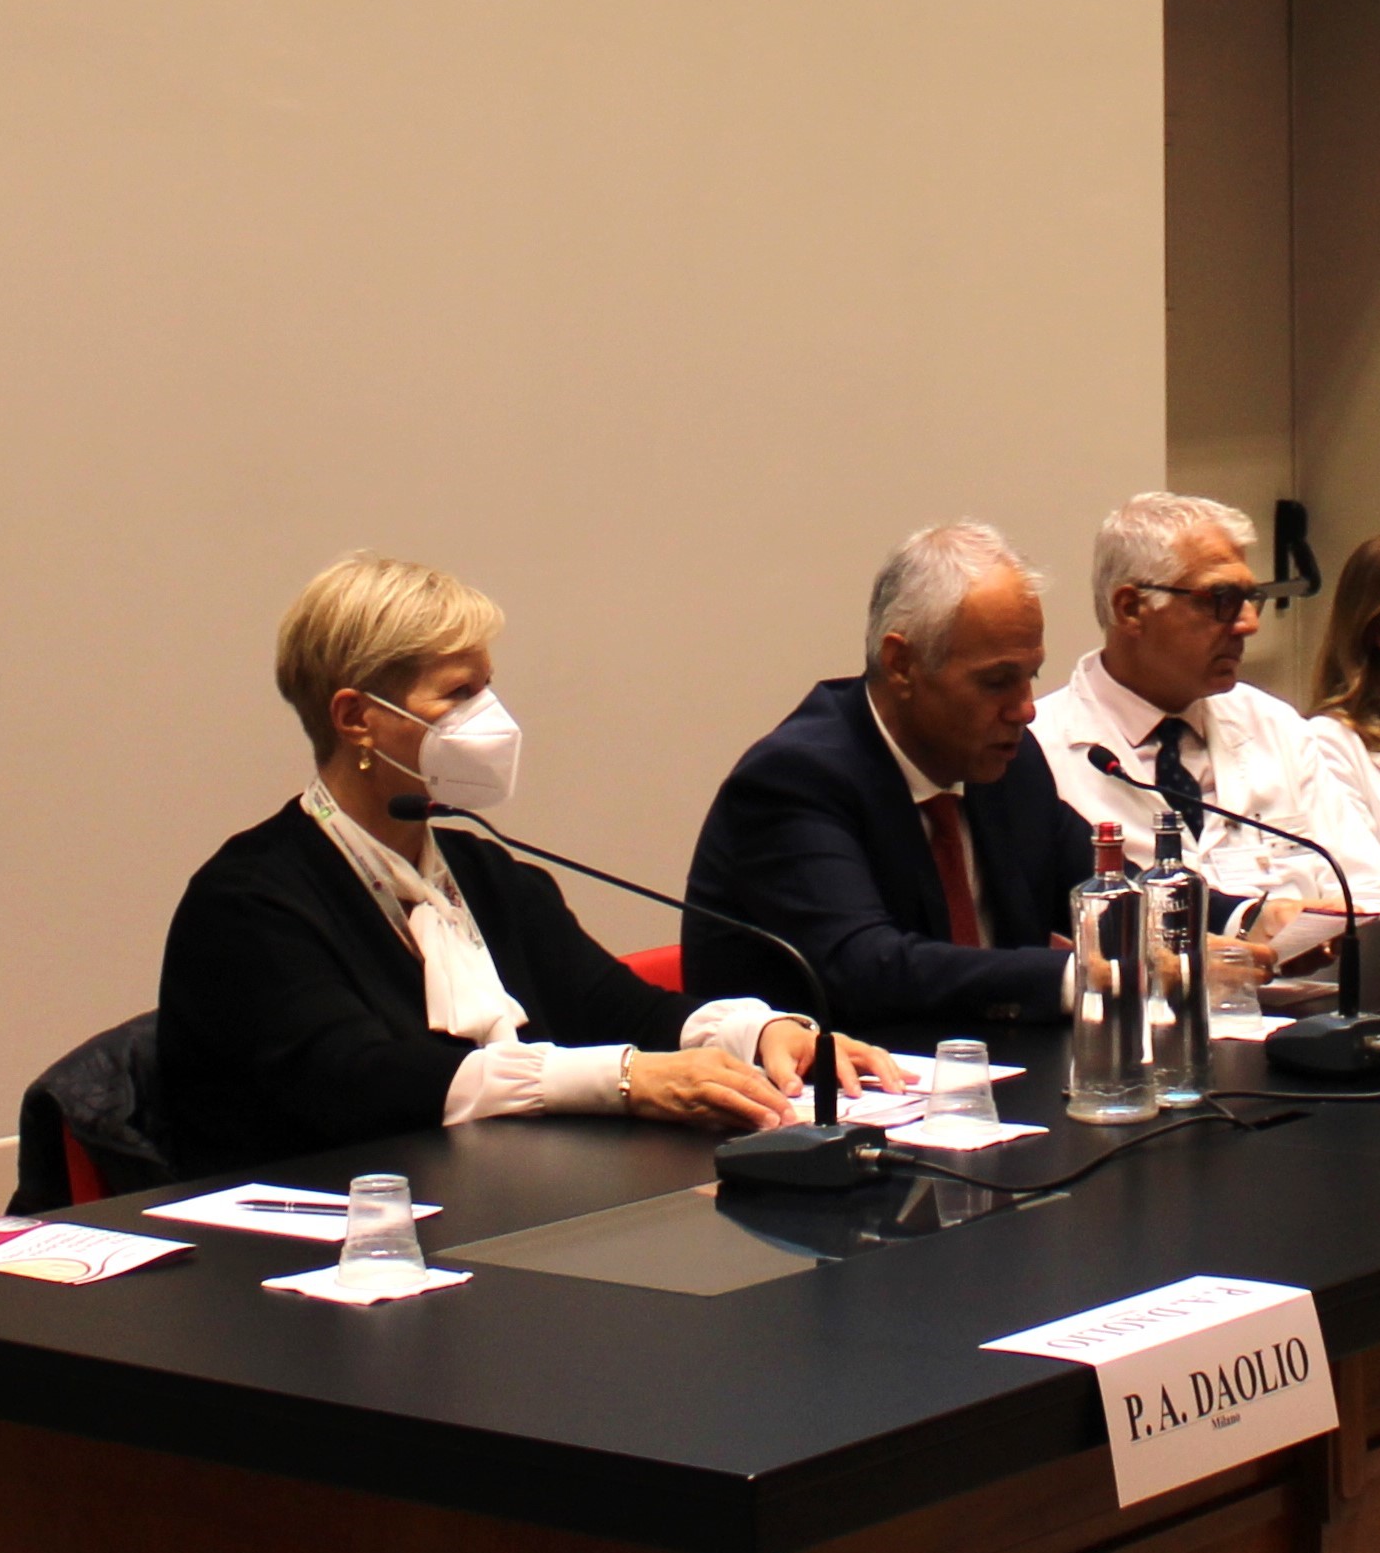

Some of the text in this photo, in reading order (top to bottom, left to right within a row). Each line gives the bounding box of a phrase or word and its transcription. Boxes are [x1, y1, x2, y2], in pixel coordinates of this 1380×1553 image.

[1123, 1337, 1310, 1442] P. A. DAOLIO
